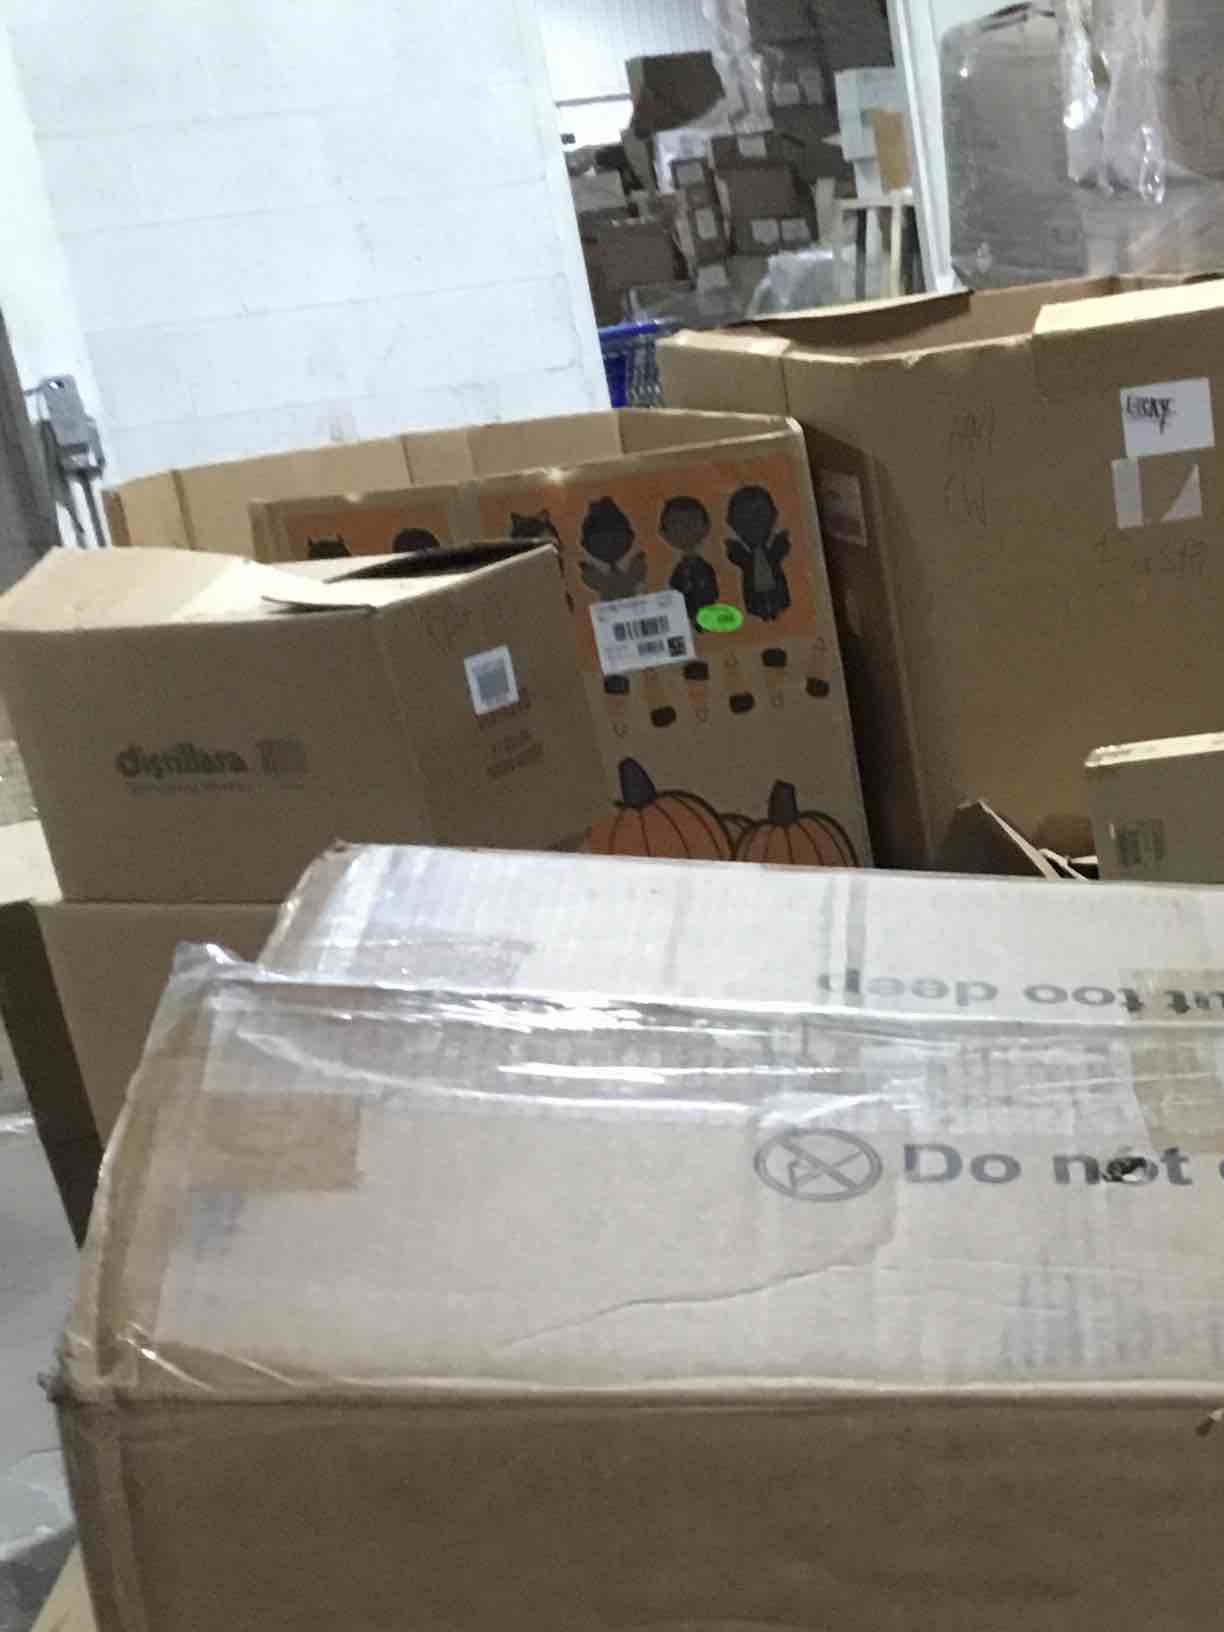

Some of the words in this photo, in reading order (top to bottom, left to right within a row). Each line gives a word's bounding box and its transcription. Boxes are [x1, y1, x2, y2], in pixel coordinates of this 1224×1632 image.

[1023, 983, 1143, 1014] too
[903, 1142, 1022, 1185] Do
[1051, 1146, 1193, 1187] not
